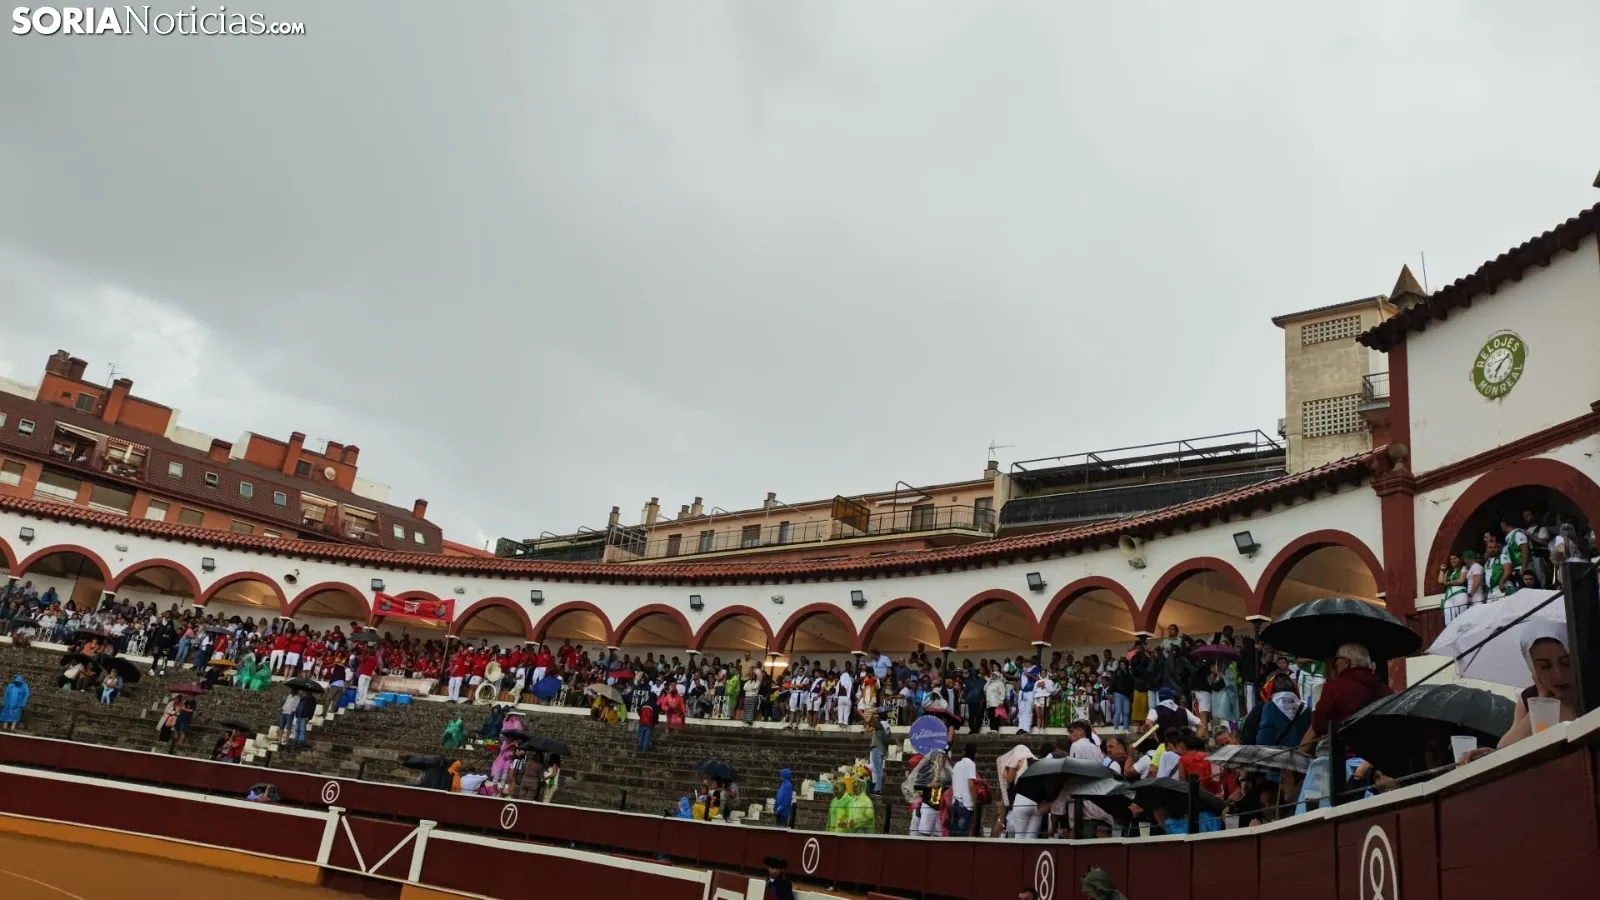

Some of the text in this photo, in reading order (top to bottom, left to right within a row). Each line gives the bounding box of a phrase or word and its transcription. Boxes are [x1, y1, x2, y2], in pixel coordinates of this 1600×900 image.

[1477, 337, 1520, 368] RELOJES
[1478, 364, 1523, 396] MONREAL
[326, 783, 336, 801] 6
[807, 843, 817, 869] 7
[1040, 860, 1050, 900] 8
